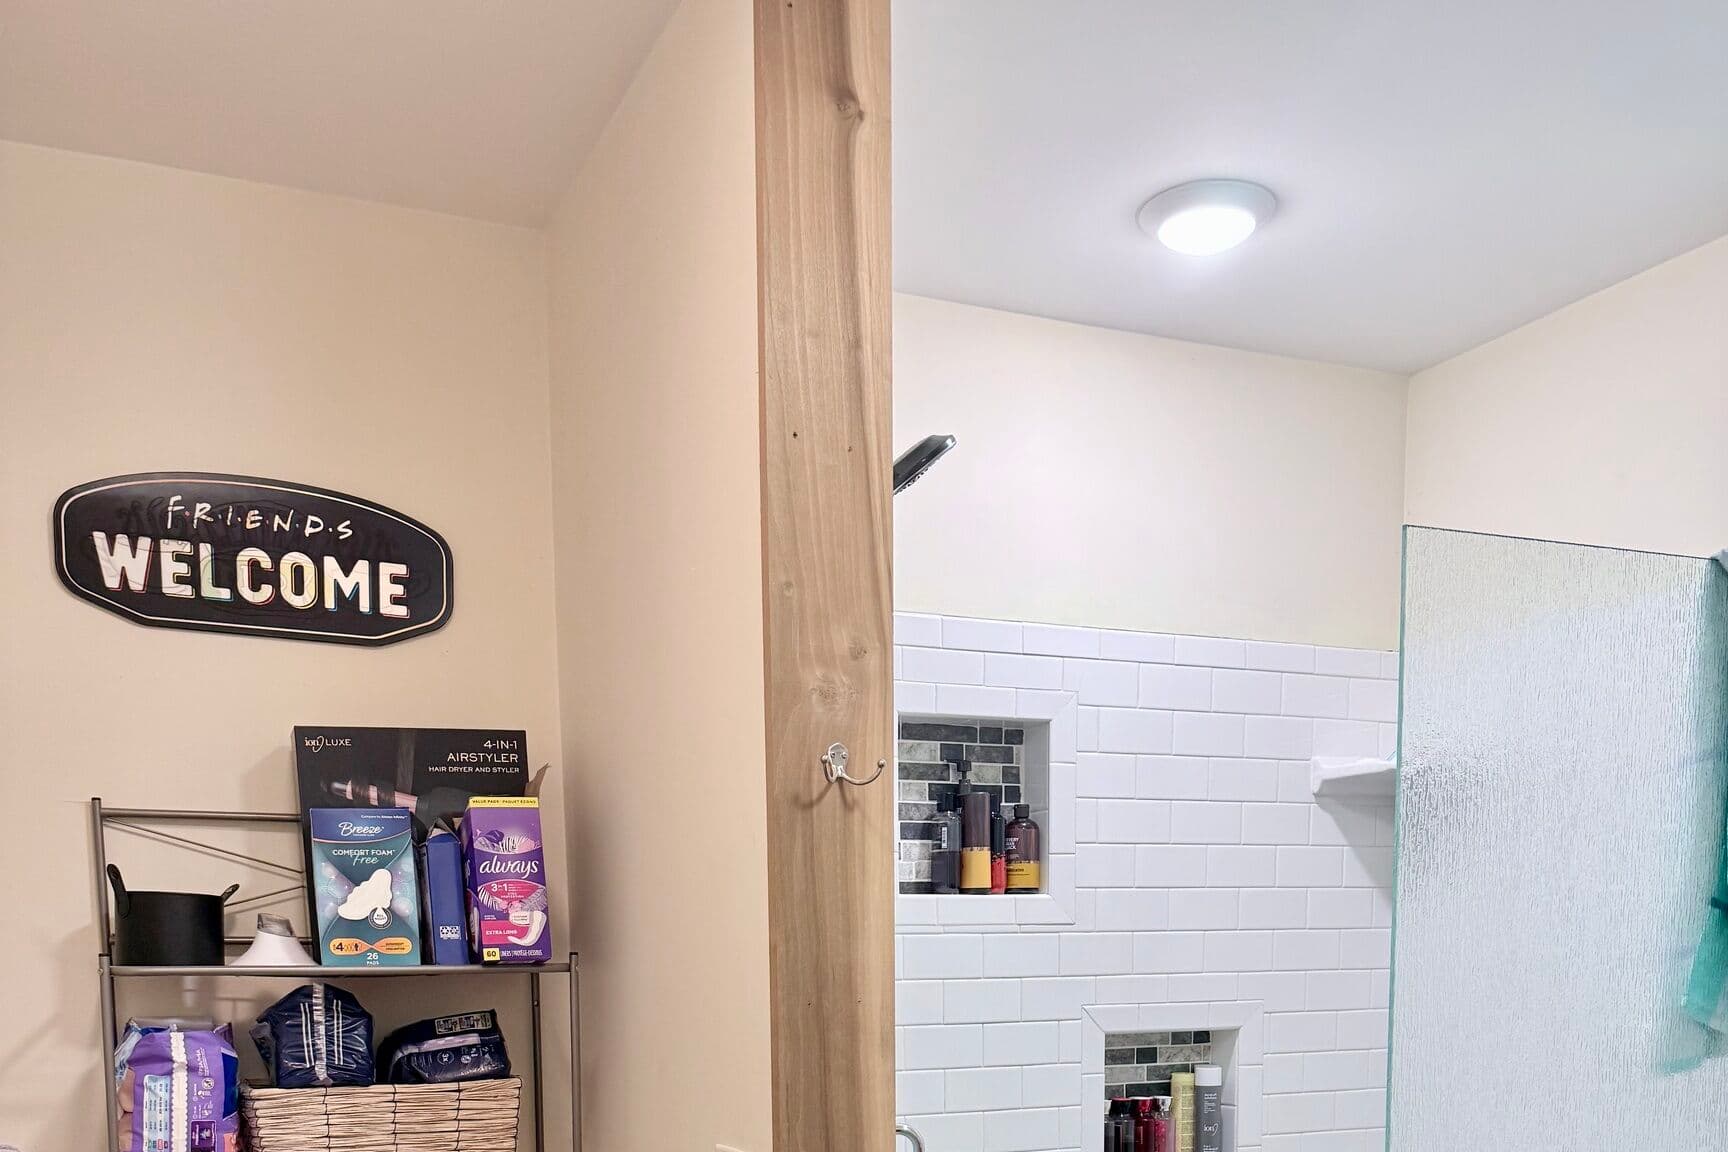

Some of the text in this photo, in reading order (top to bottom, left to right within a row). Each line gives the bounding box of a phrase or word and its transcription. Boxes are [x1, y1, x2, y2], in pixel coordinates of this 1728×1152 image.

[92, 530, 410, 618] WELCOME
[325, 738, 352, 747] LUXE
[483, 740, 518, 750] 4-IN-1
[447, 752, 519, 763] AIRSTYLER
[338, 821, 382, 837] Breeze
[479, 855, 539, 879] always
[366, 952, 379, 960] 26
